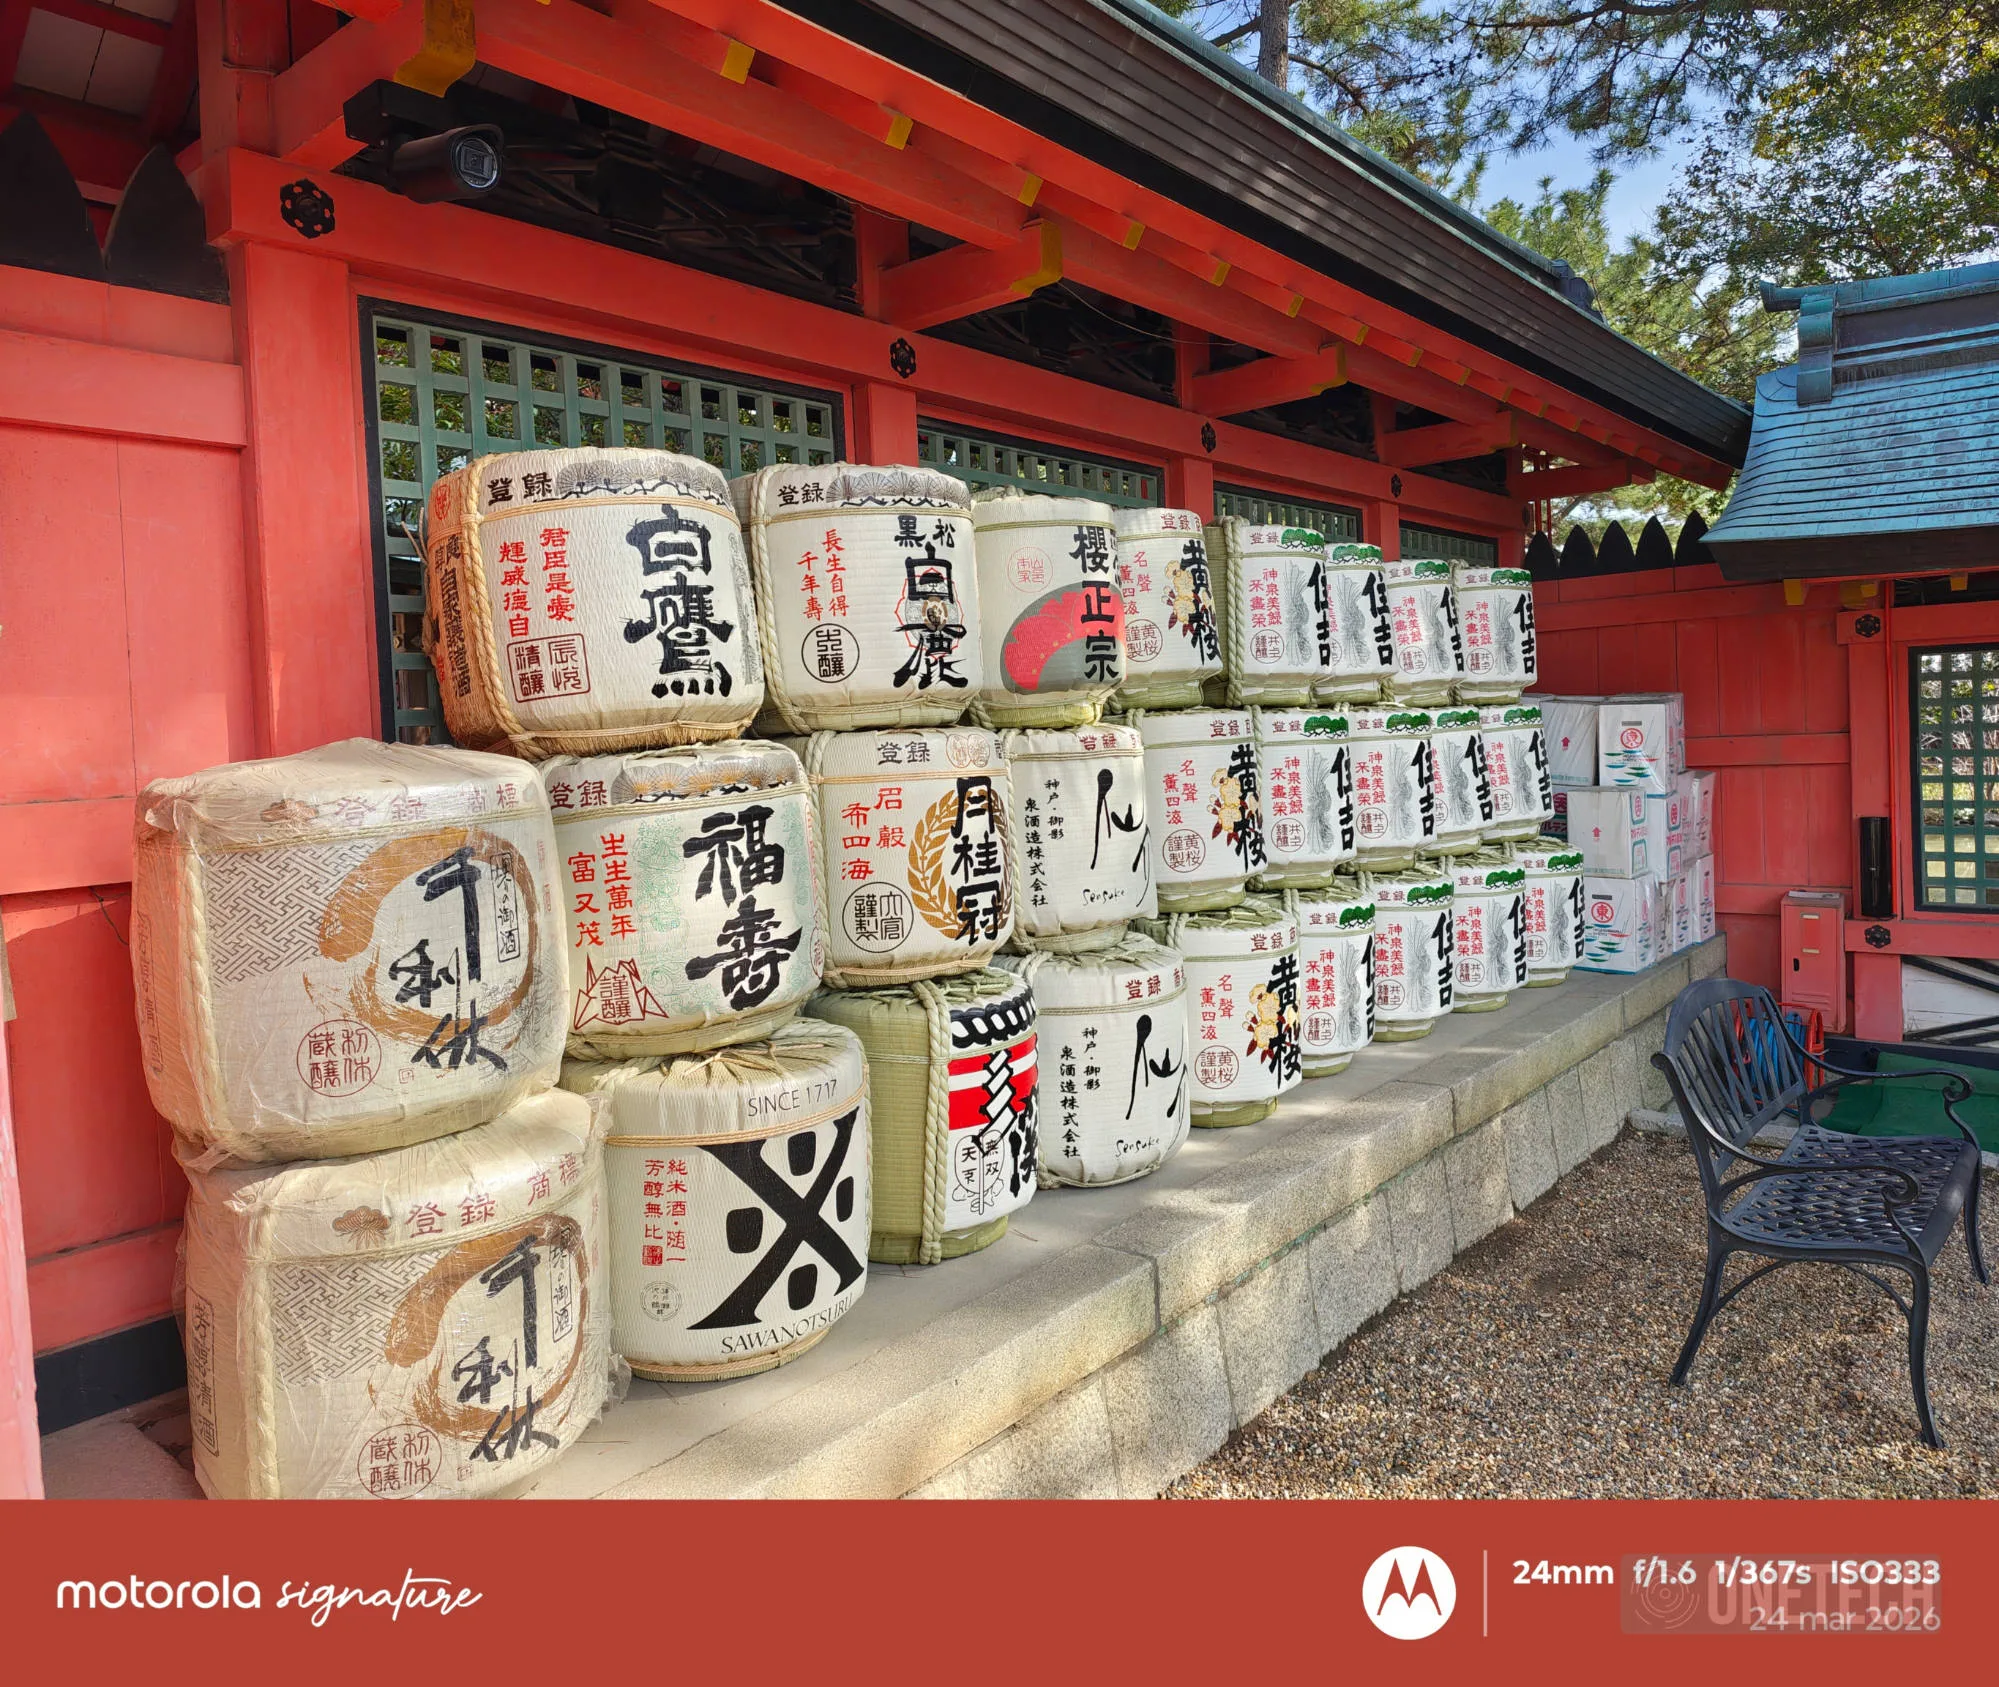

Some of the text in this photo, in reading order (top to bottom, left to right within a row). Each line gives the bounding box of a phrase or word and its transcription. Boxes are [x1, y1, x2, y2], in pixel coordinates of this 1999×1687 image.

[487, 471, 552, 506] 登録
[777, 483, 825, 507] 登録
[619, 503, 735, 699] 白鷹
[878, 741, 930, 765] 登録
[550, 780, 608, 810] 登録
[950, 776, 1000, 946] 月桂冠
[1024, 798, 1048, 907] 泉酒造株式会社
[748, 1079, 838, 1117] SINCE 1717
[1060, 1046, 1081, 1159] 泉酒造株式会社
[721, 1292, 853, 1355] SAWANOTSURU
